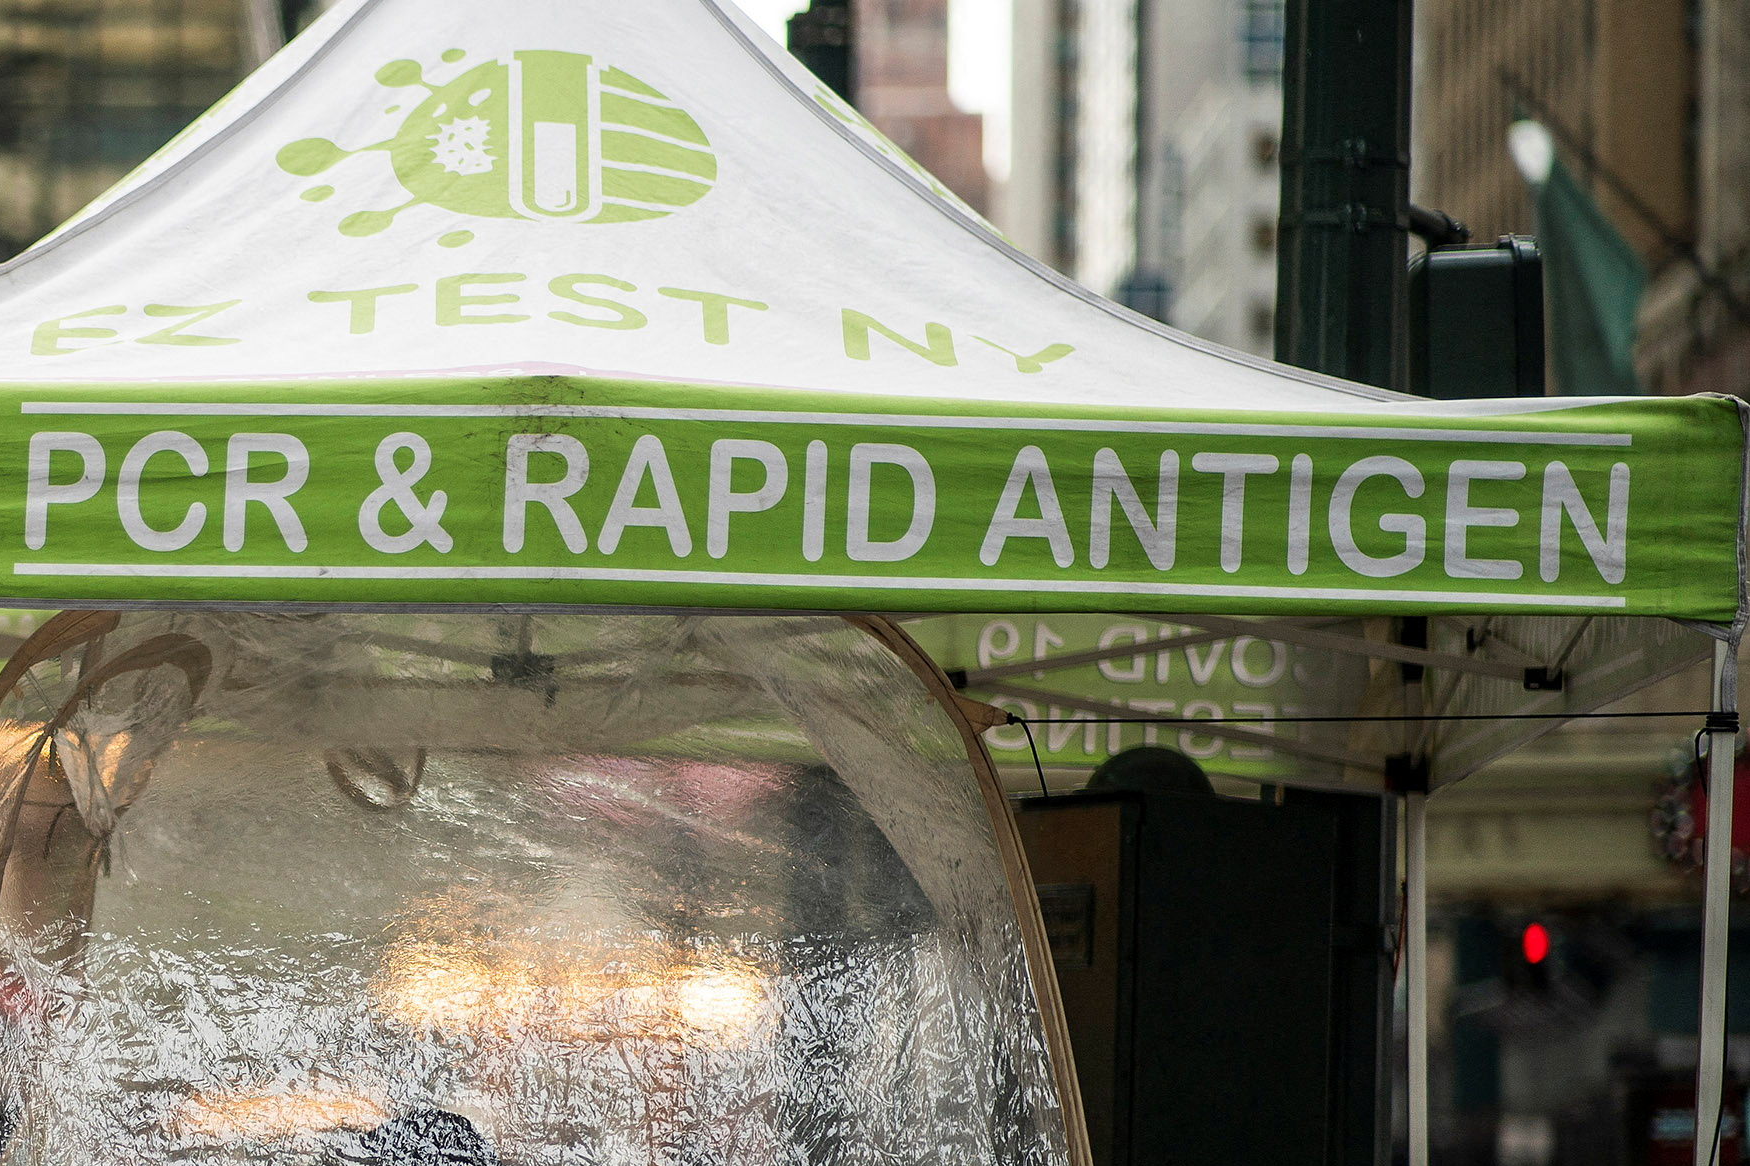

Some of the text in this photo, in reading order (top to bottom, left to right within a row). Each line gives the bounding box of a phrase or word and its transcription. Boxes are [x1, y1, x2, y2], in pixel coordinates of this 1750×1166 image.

[31, 272, 1076, 375] EZ TEST NY
[23, 430, 1632, 586] PCR & RAPID ANTIGEN
